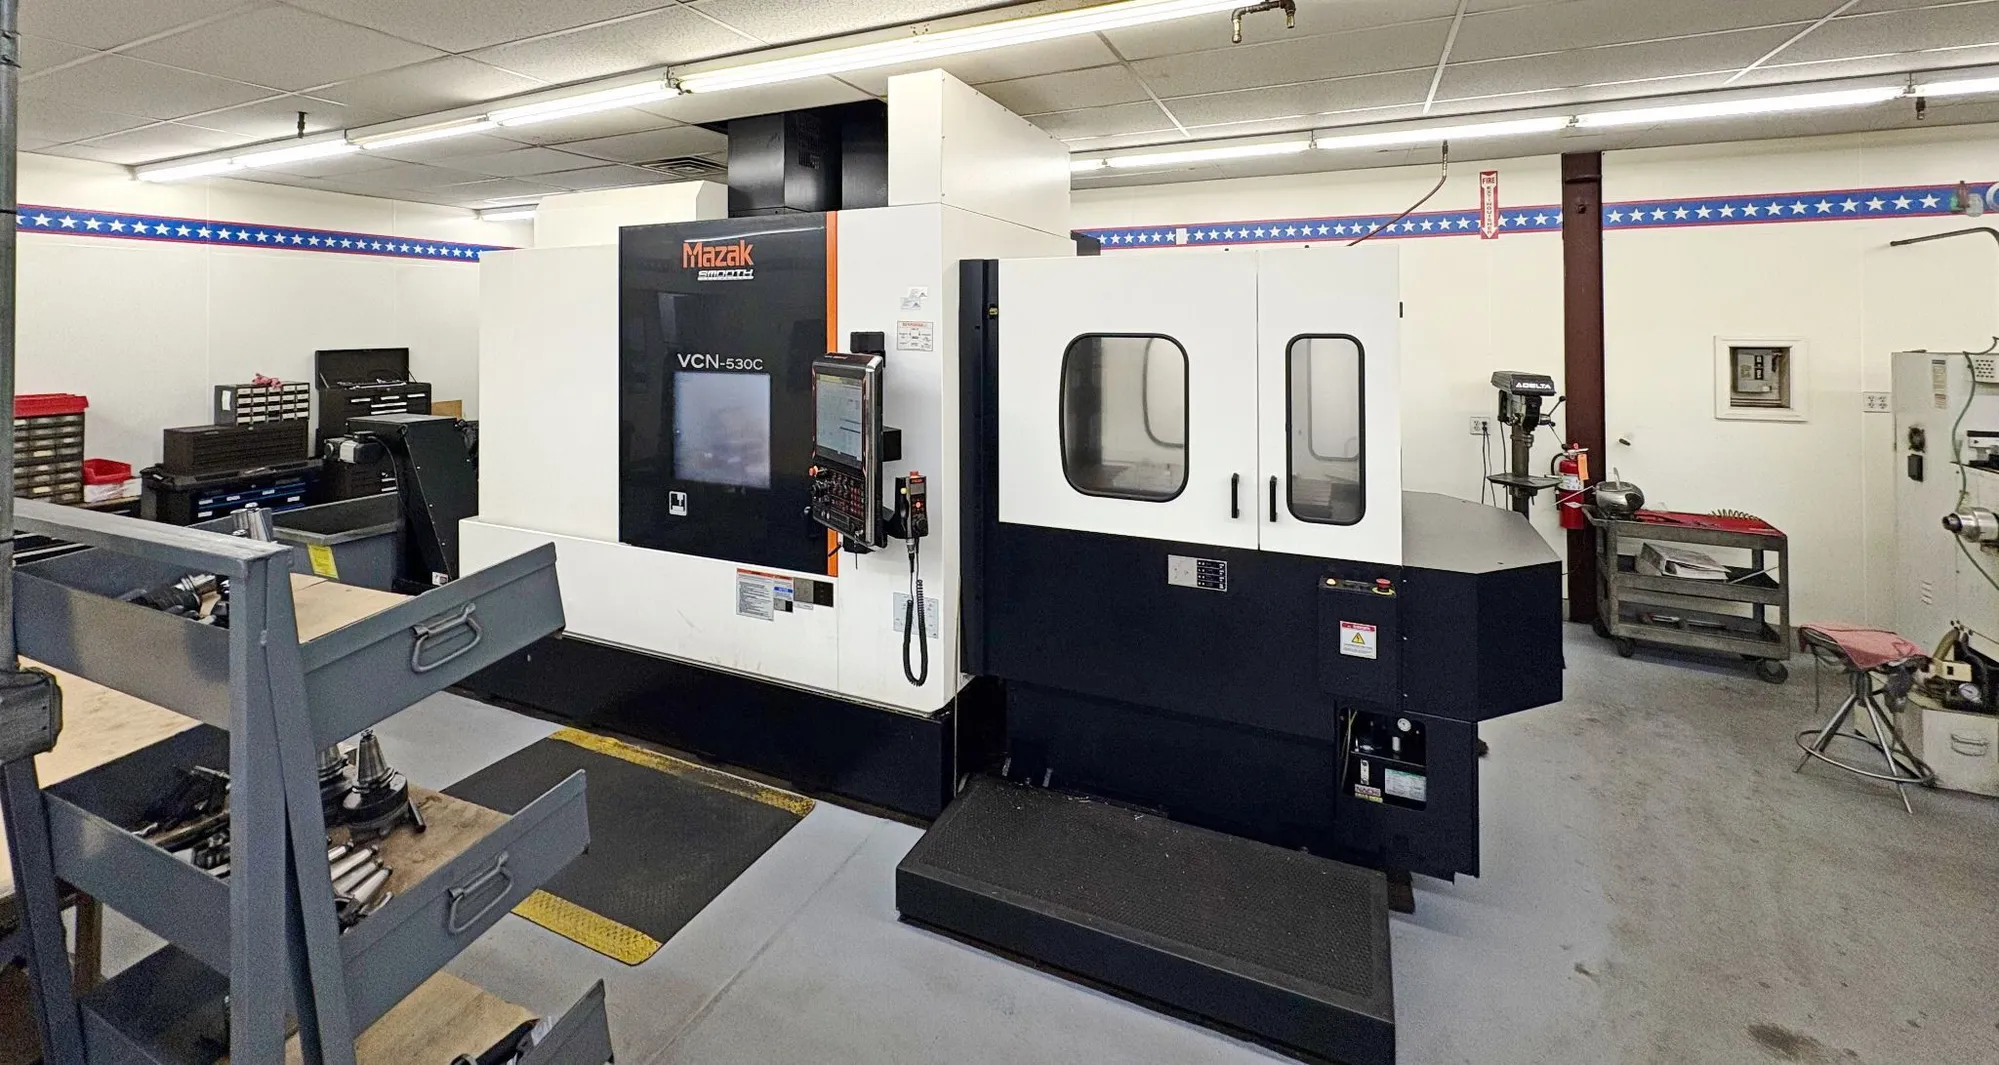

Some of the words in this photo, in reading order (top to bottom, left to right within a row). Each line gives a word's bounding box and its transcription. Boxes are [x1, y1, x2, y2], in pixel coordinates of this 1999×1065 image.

[683, 240, 754, 268] Mazak
[698, 269, 754, 279] SMOOTH
[677, 353, 764, 370] VCN-530C
